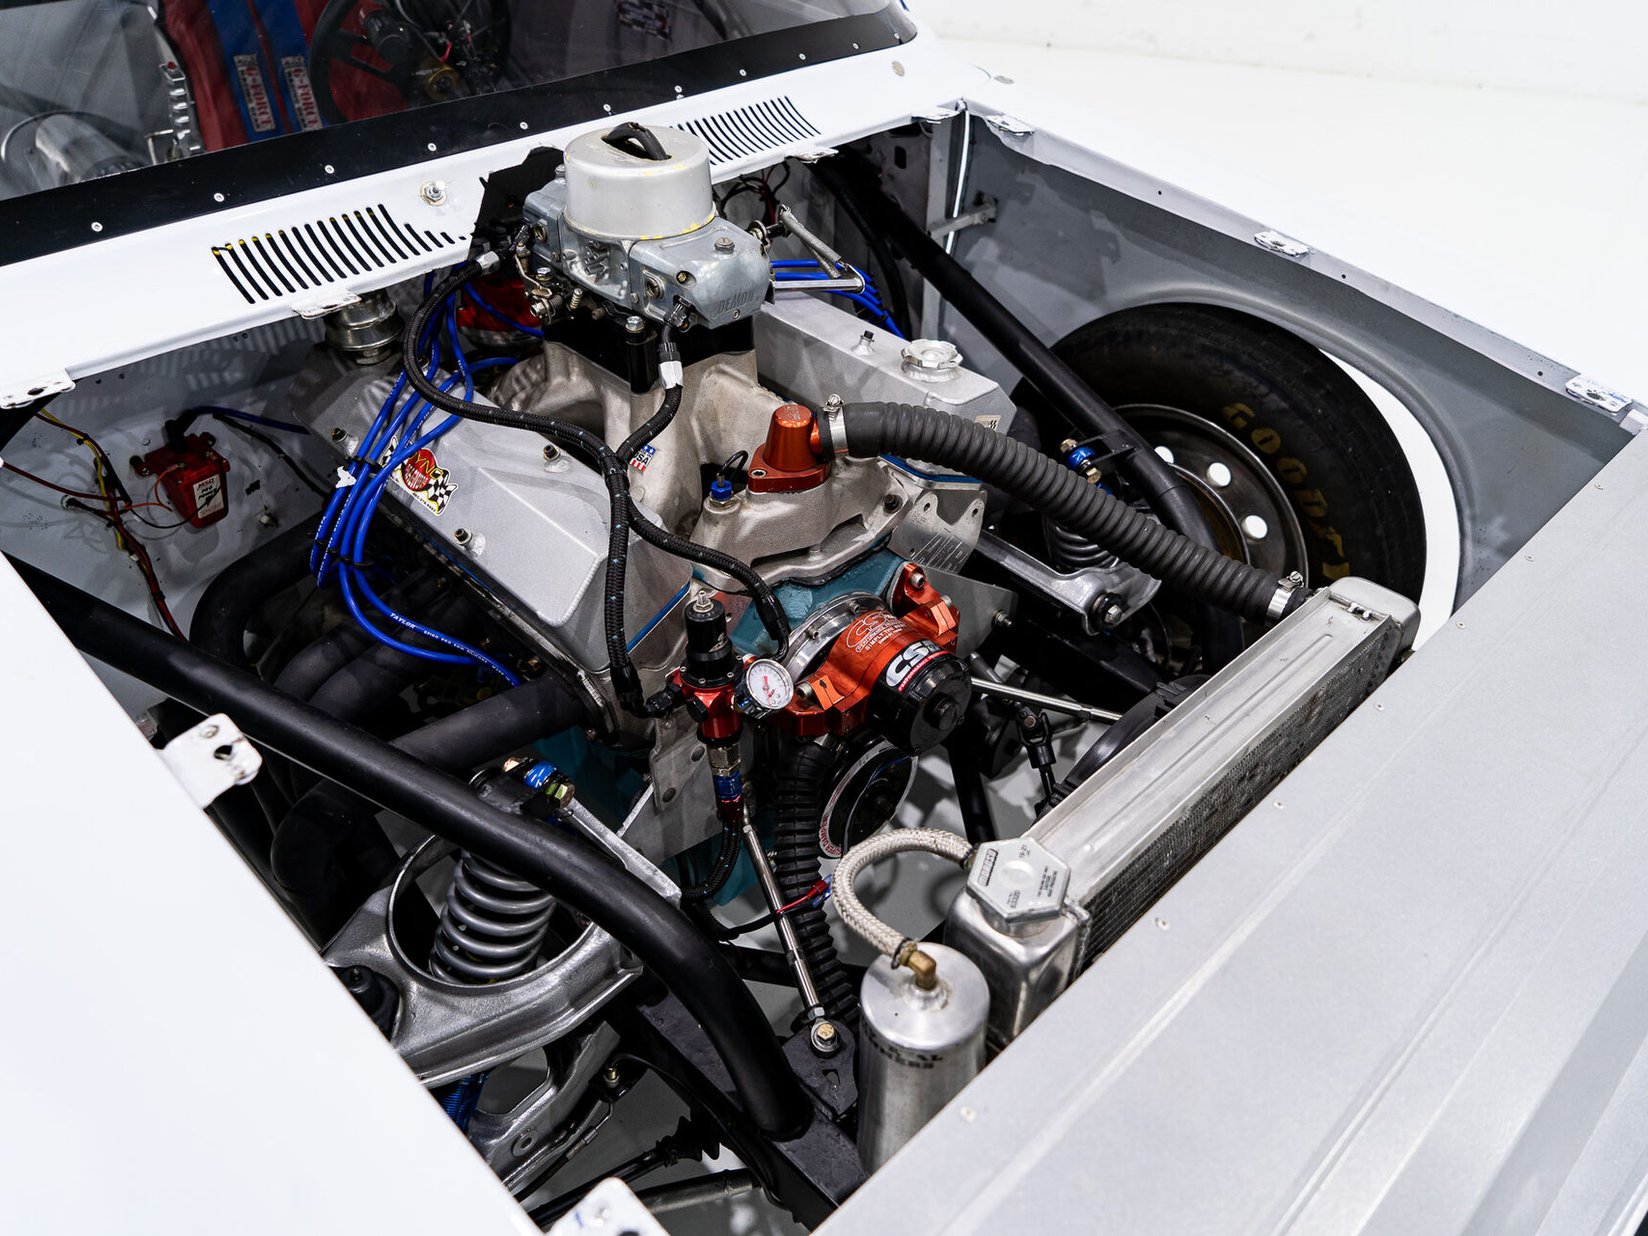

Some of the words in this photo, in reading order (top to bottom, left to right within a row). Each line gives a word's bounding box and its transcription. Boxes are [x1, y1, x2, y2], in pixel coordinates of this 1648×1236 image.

[245, 67, 273, 126] G-FORCE
[292, 68, 320, 126] G-FORCE
[390, 612, 416, 630] TAYLOR
